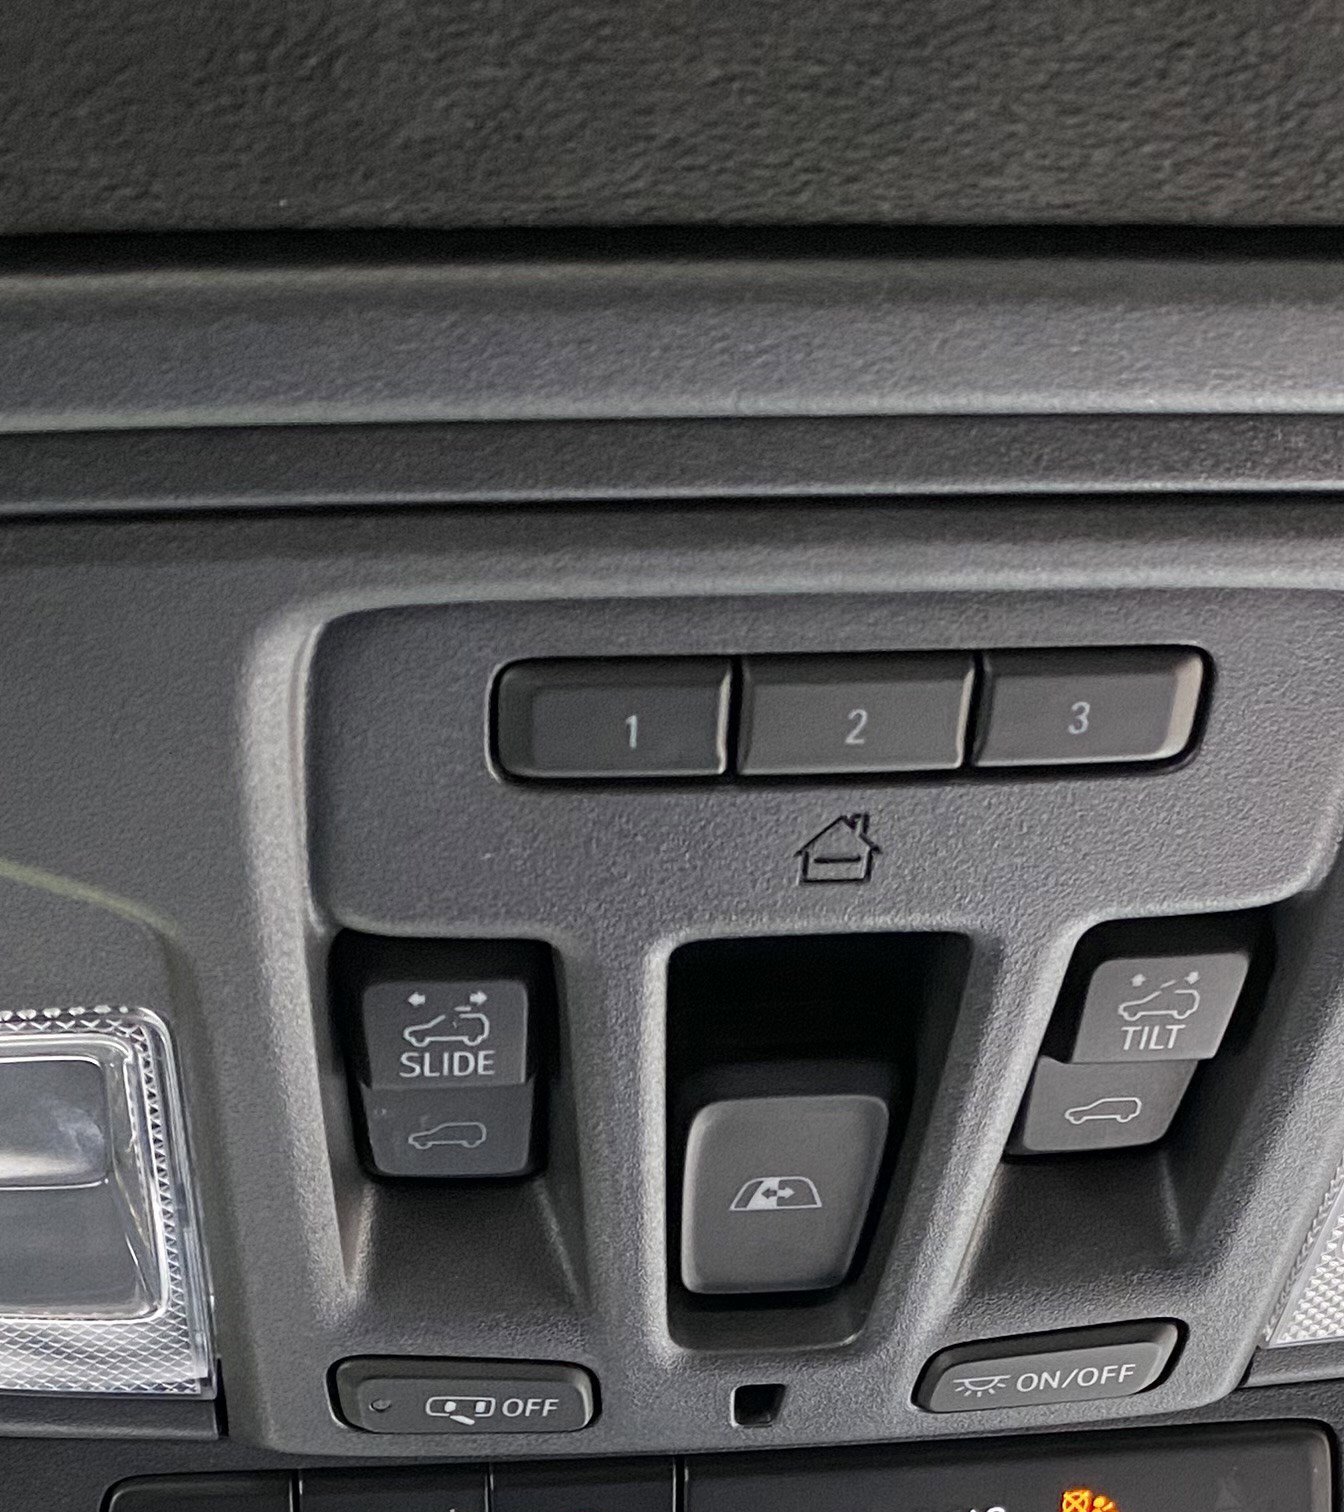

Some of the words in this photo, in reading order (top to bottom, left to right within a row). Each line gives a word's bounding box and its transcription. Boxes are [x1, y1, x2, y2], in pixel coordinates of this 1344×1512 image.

[625, 714, 639, 749] 1
[844, 709, 868, 745] 2
[1067, 701, 1091, 735] 3
[1121, 1024, 1186, 1050] TILT
[399, 1050, 495, 1077] SLIDE
[1016, 1363, 1136, 1393] ON/OFF
[502, 1398, 560, 1418] OFF
